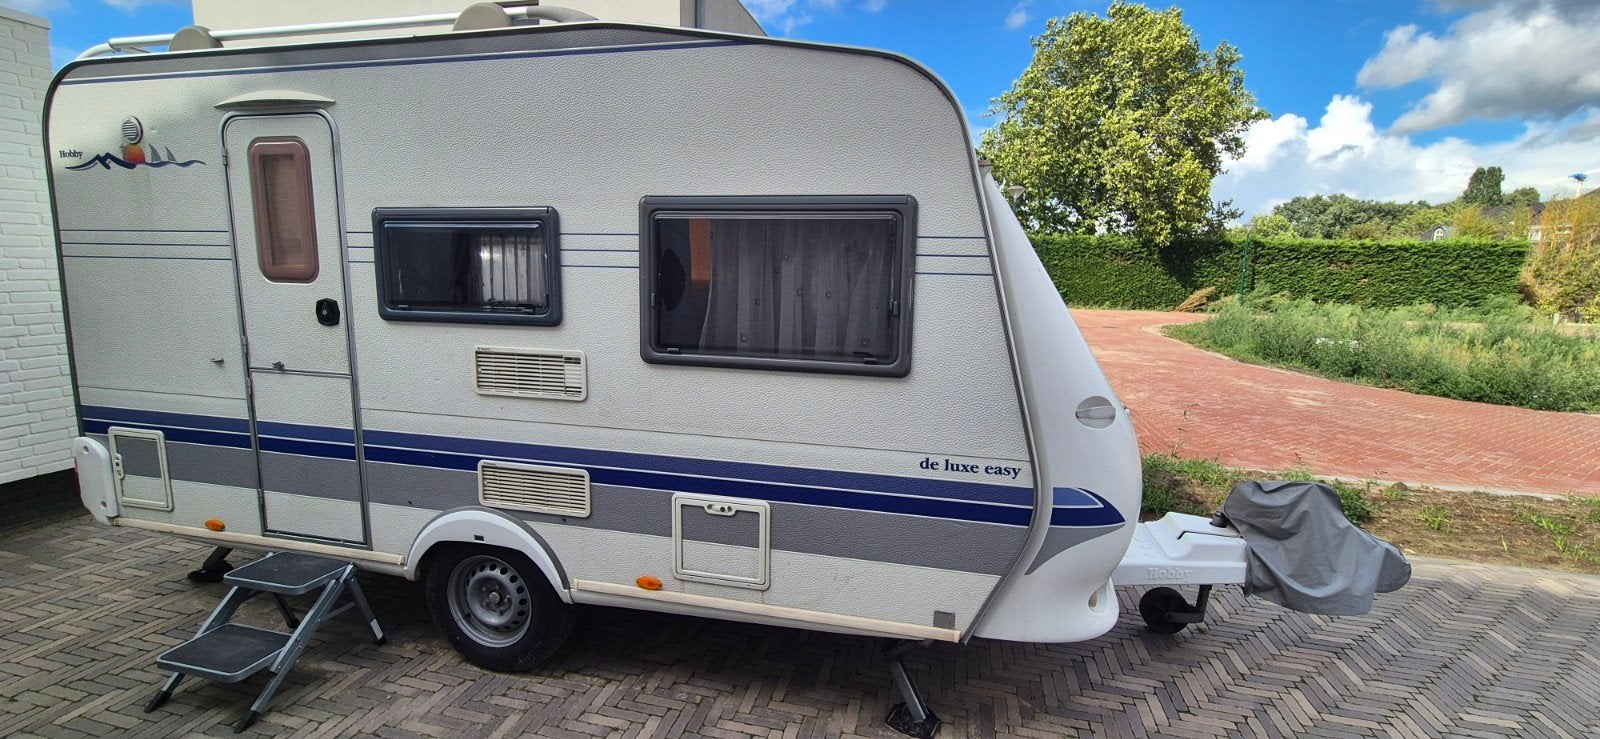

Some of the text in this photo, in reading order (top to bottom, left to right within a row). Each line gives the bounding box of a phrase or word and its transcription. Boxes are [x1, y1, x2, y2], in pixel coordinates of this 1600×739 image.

[59, 149, 83, 159] Hobby
[920, 457, 1021, 479] de luxe easy
[1146, 566, 1193, 582] Hobby
